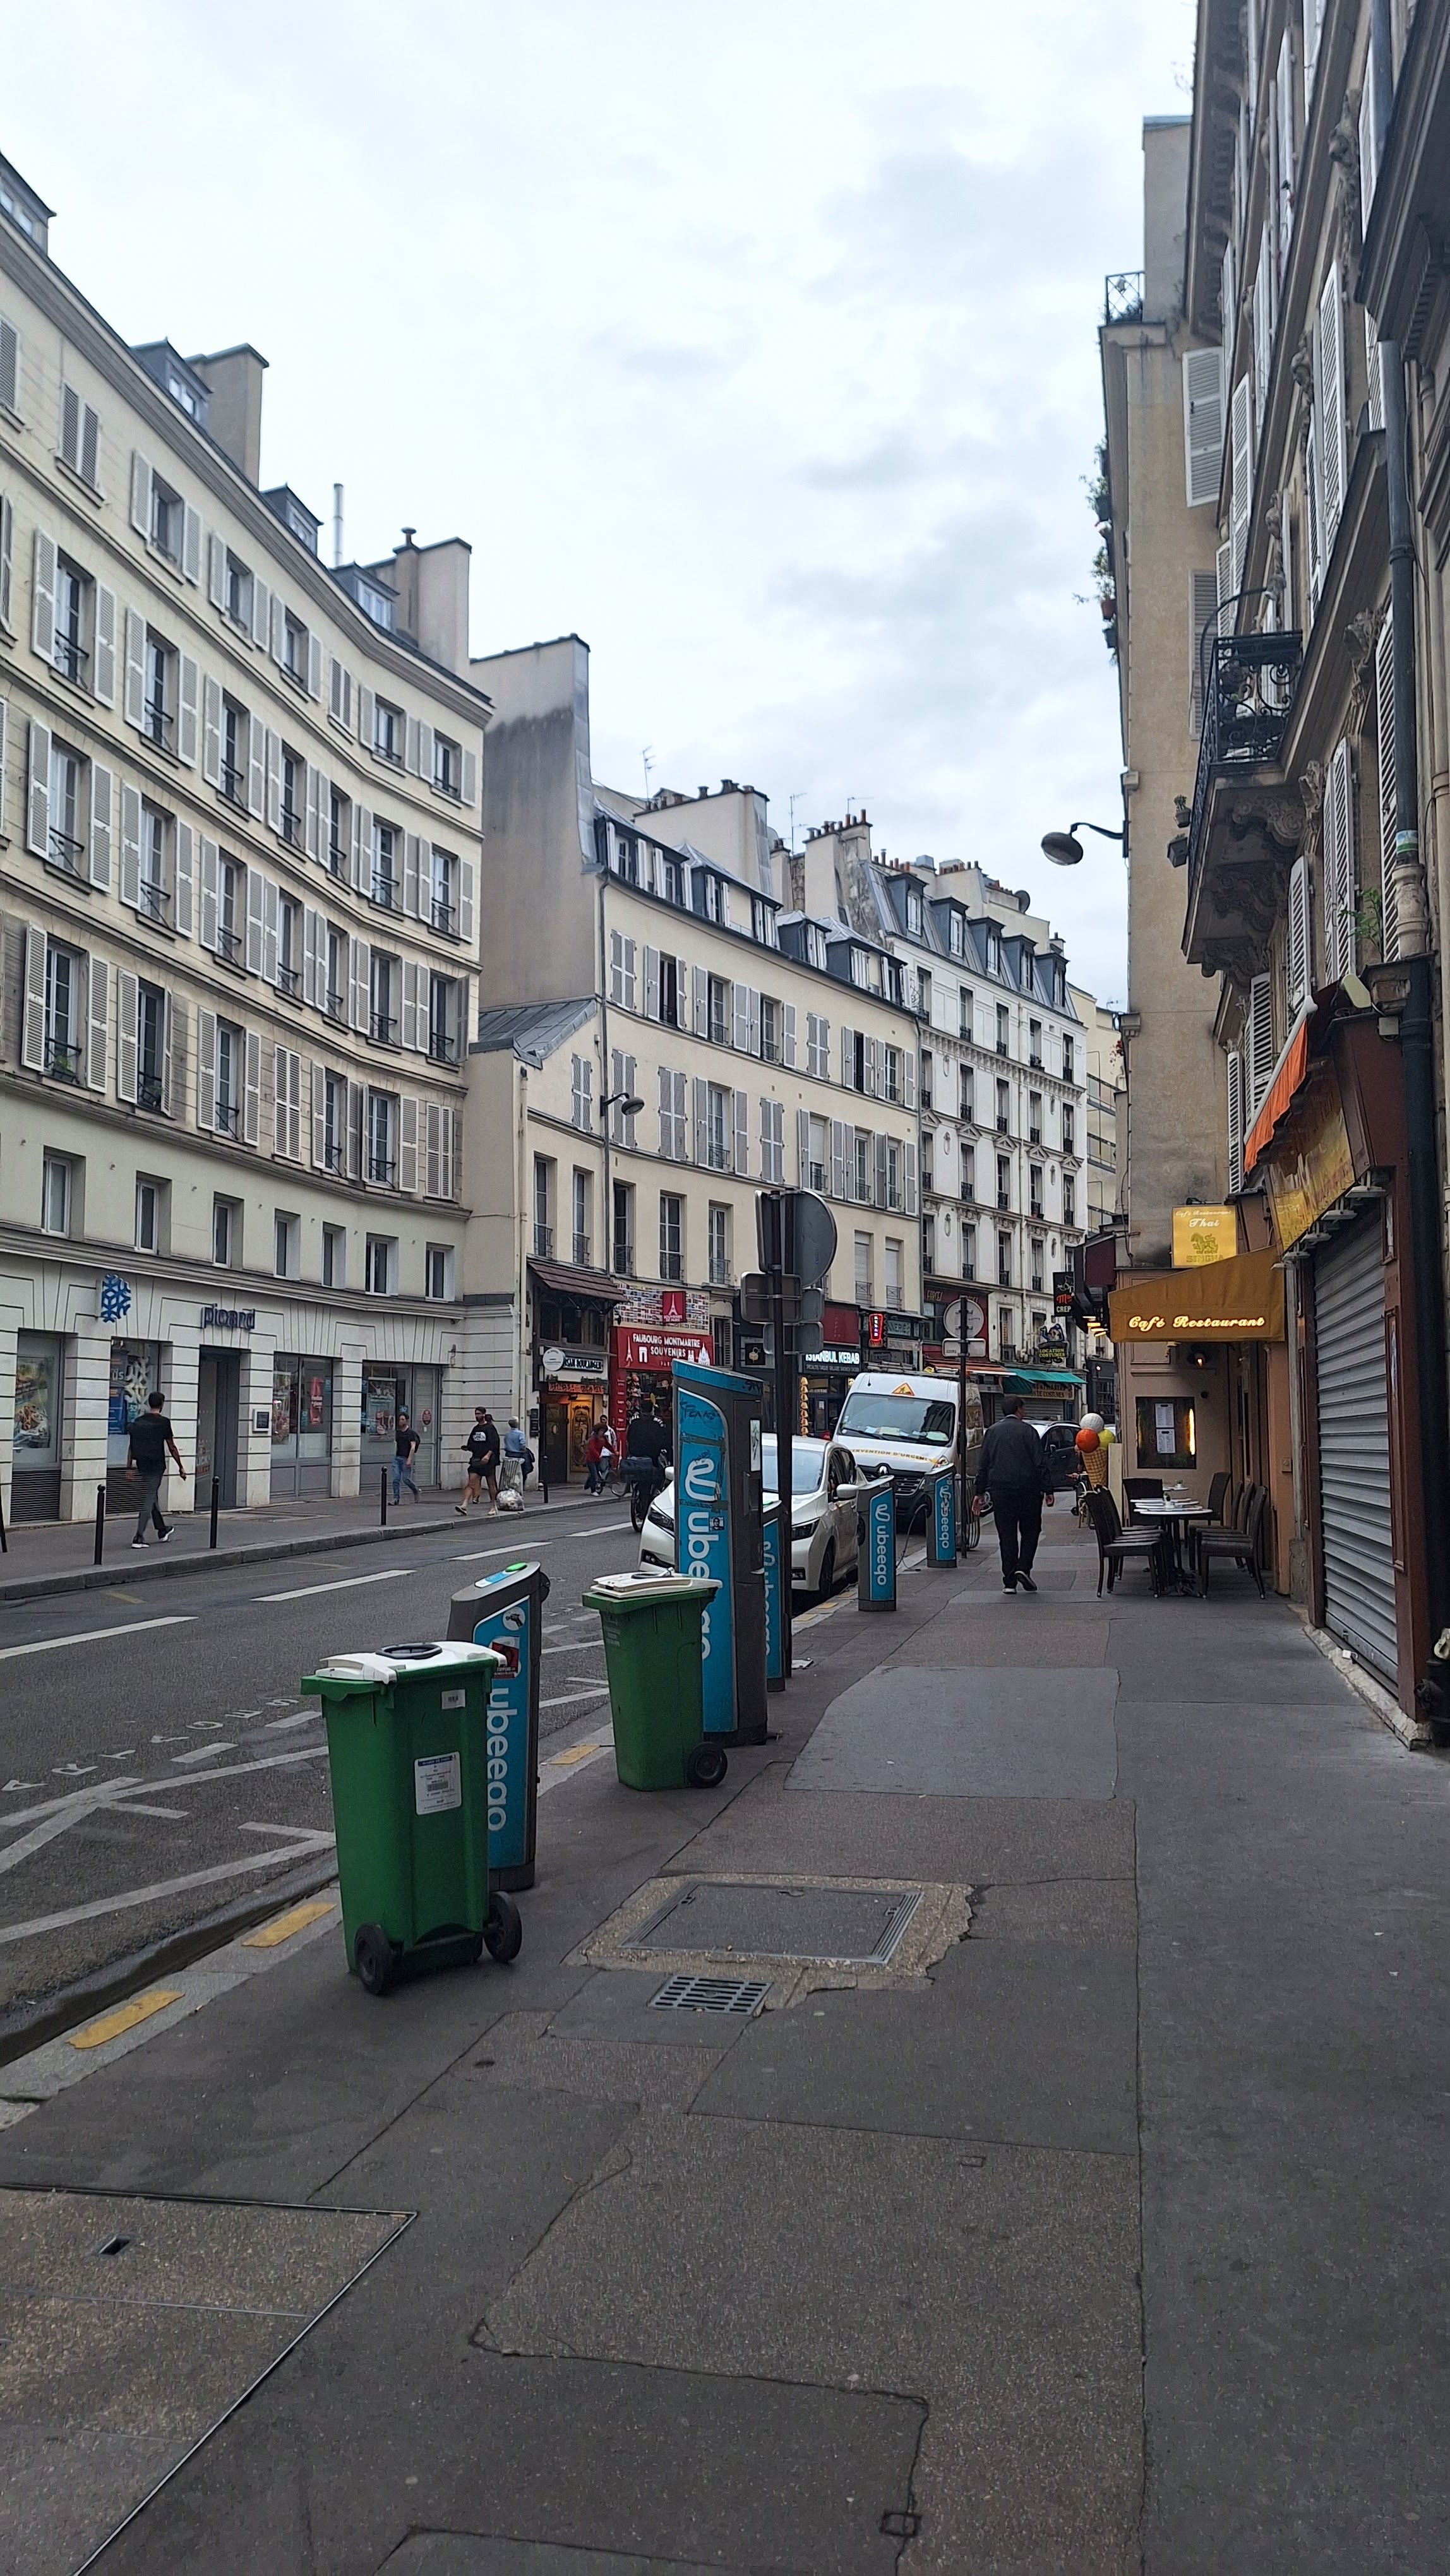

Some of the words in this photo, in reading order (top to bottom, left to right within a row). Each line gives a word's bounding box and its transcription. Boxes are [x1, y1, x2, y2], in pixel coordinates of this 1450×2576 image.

[1186, 1255, 1223, 1263] SINGHA
[201, 1303, 255, 1330] picard
[1129, 1316, 1165, 1332] Café
[1173, 1316, 1265, 1328] Restaurant
[633, 1333, 662, 1345] FAUBOURG
[664, 1337, 701, 1348] MONTMARTRE
[650, 1346, 686, 1357] SOUVENIRS
[805, 1350, 837, 1363] ISTANBUL
[838, 1351, 860, 1364] KEBAB
[874, 1525, 890, 1585] ubeeqo
